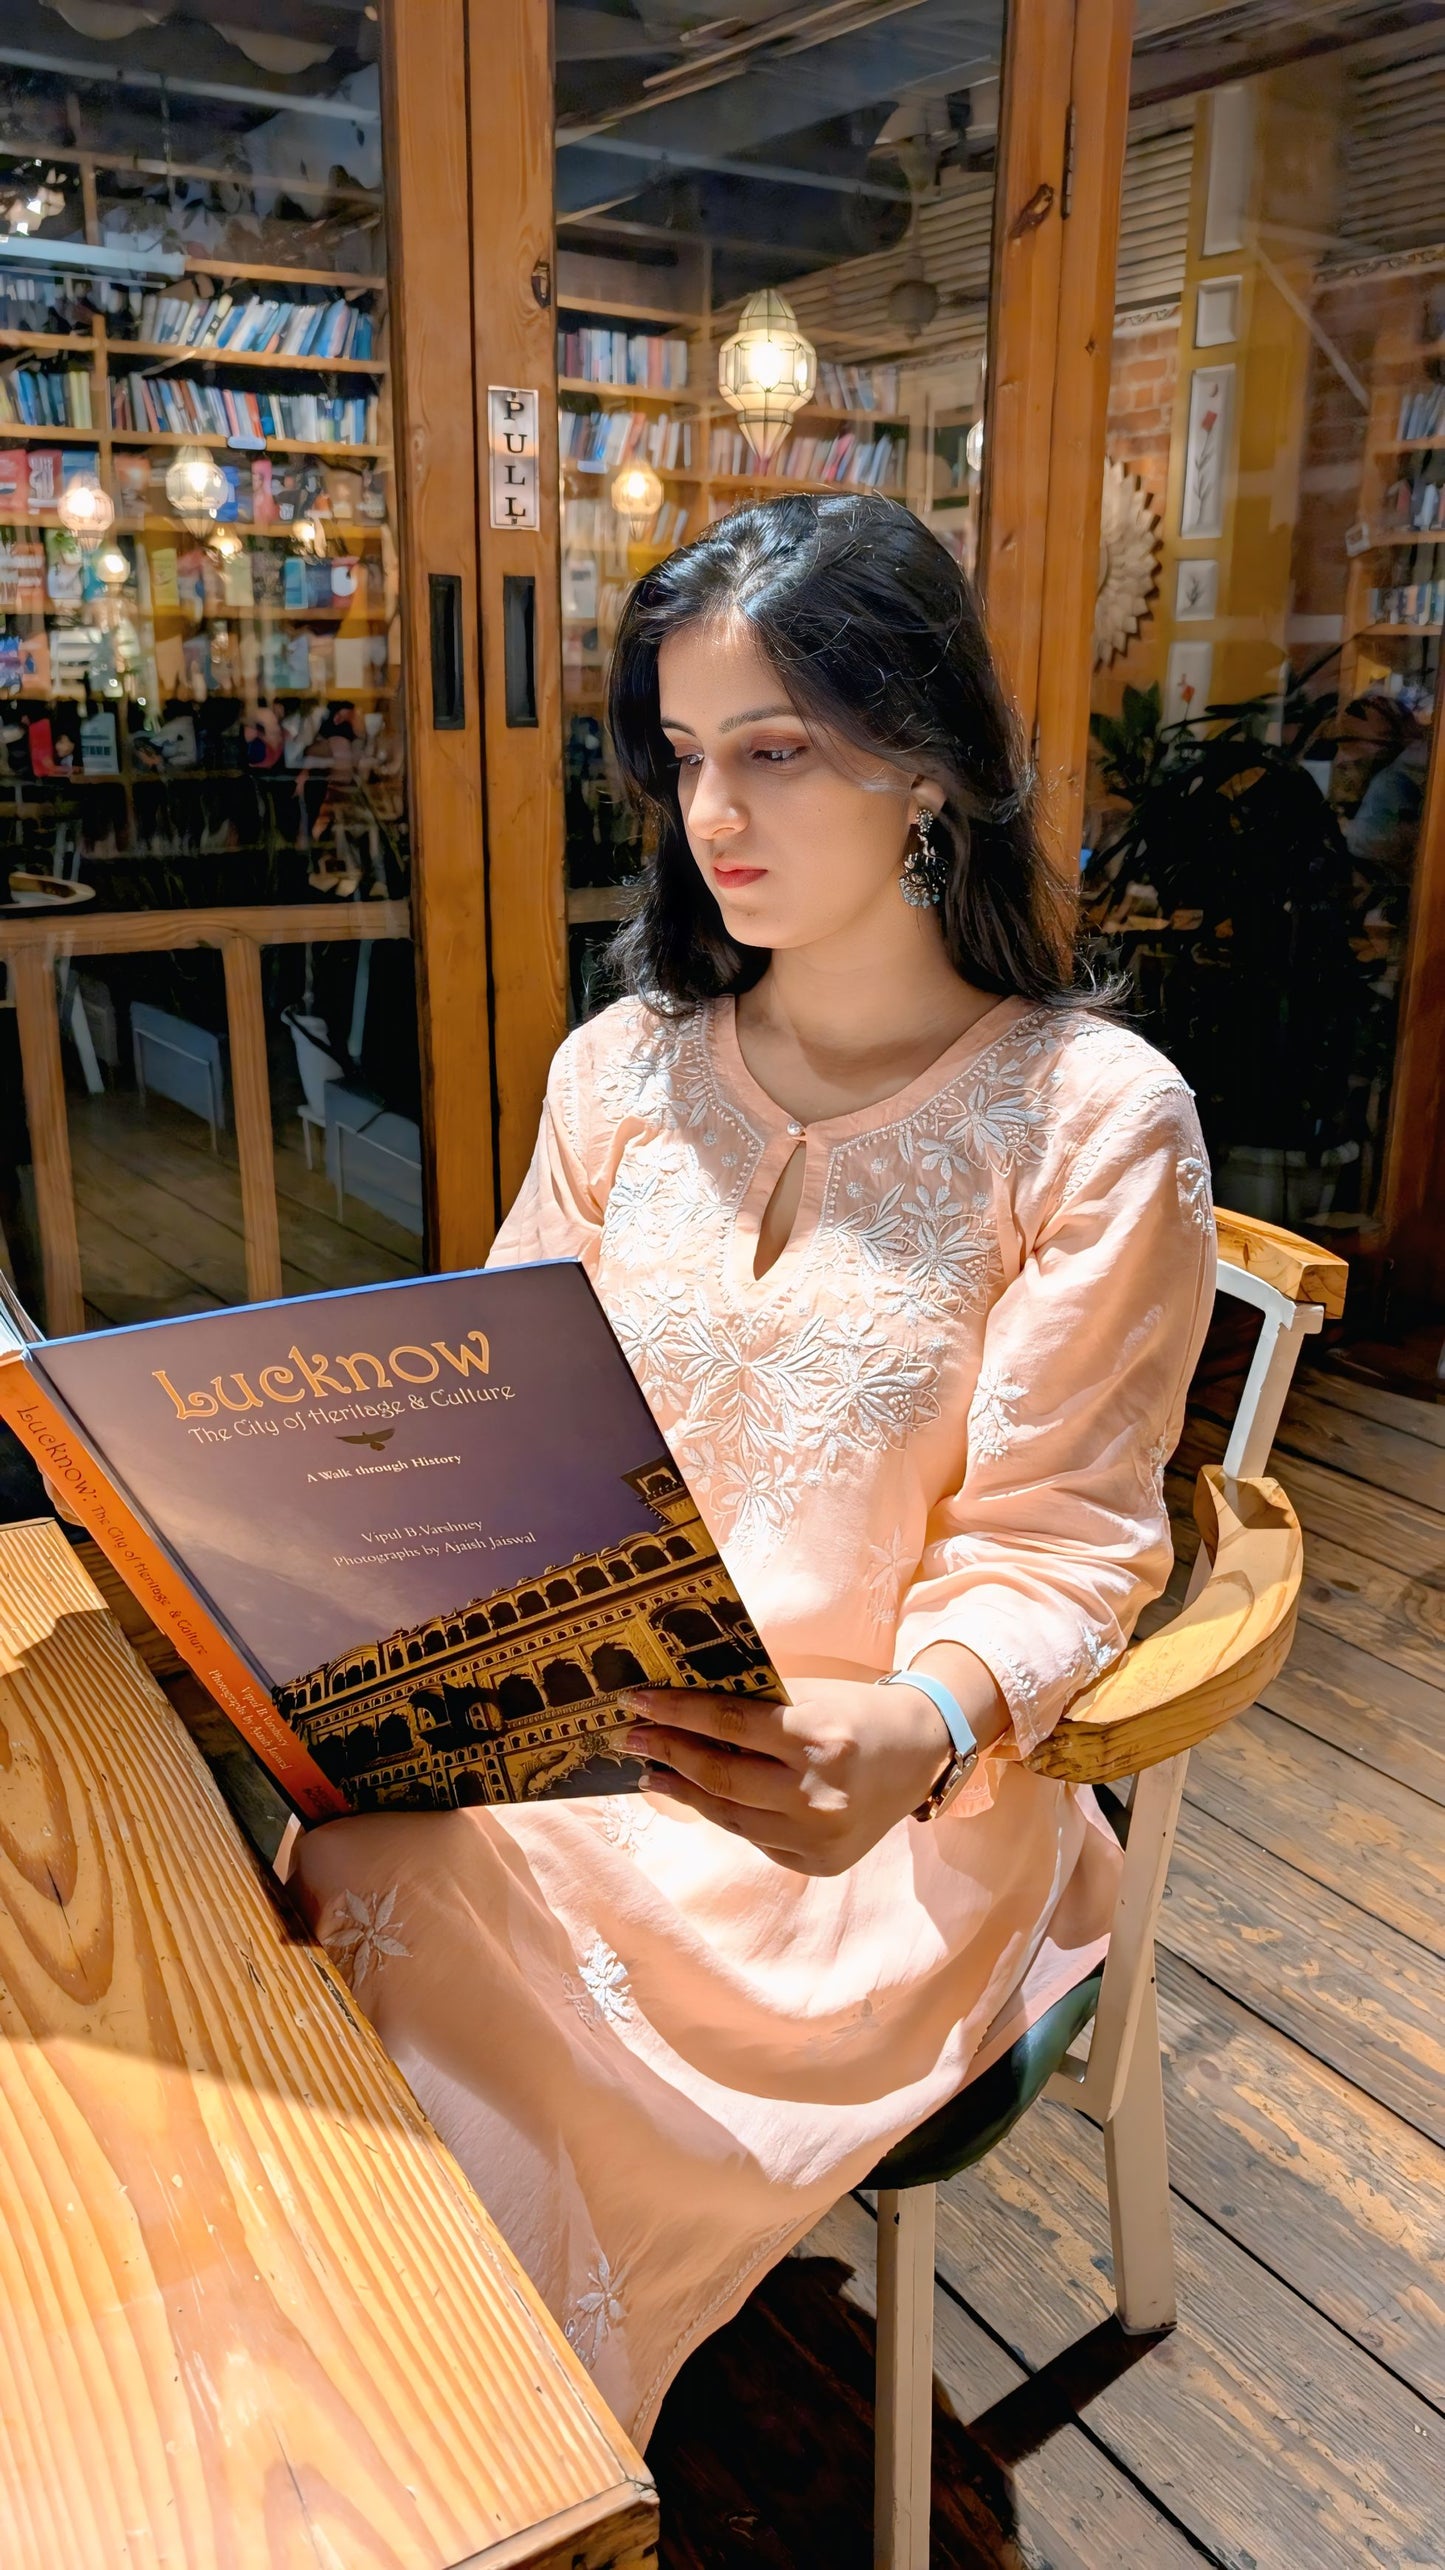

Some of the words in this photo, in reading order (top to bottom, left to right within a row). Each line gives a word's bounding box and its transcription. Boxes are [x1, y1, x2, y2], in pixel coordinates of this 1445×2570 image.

[503, 400, 528, 517] PULL
[152, 1330, 490, 1420] Lucknow
[188, 1427, 233, 1444] The
[233, 1418, 280, 1437] City
[283, 1411, 307, 1431] of
[308, 1400, 406, 1426] Heritage
[408, 1394, 429, 1410] &
[430, 1386, 516, 1408] Culture
[306, 1473, 318, 1483] A
[317, 1467, 352, 1481] Walk
[355, 1460, 409, 1476] through
[410, 1454, 462, 1468] History
[16, 1405, 98, 1502] Lucknow:
[92, 1506, 110, 1526] The
[107, 1526, 128, 1549] City
[169, 1610, 182, 1619] &
[360, 1528, 402, 1545] Vipul
[332, 1548, 421, 1567] Photographs
[422, 1543, 441, 1557] by
[444, 1537, 487, 1555] Ajaish
[488, 1531, 537, 1551] Jaiswal
